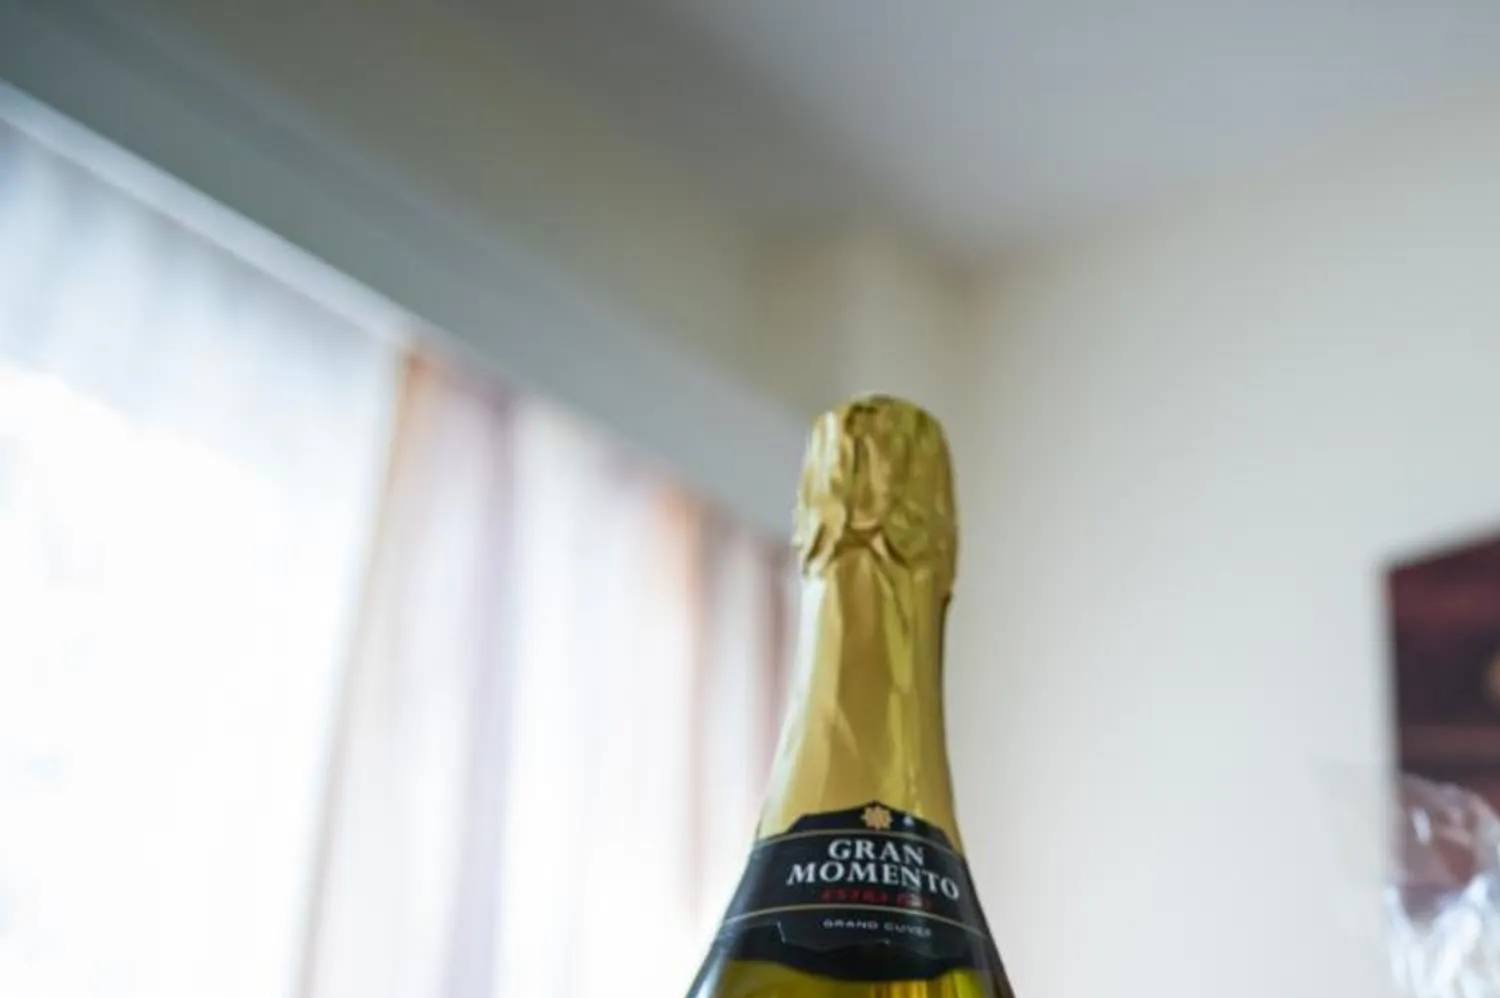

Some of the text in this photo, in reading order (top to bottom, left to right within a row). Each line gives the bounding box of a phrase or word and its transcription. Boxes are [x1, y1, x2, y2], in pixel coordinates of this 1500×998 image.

[828, 839, 924, 864] GRAN
[786, 860, 960, 900] MOMENTO
[822, 919, 879, 930] GRAND
